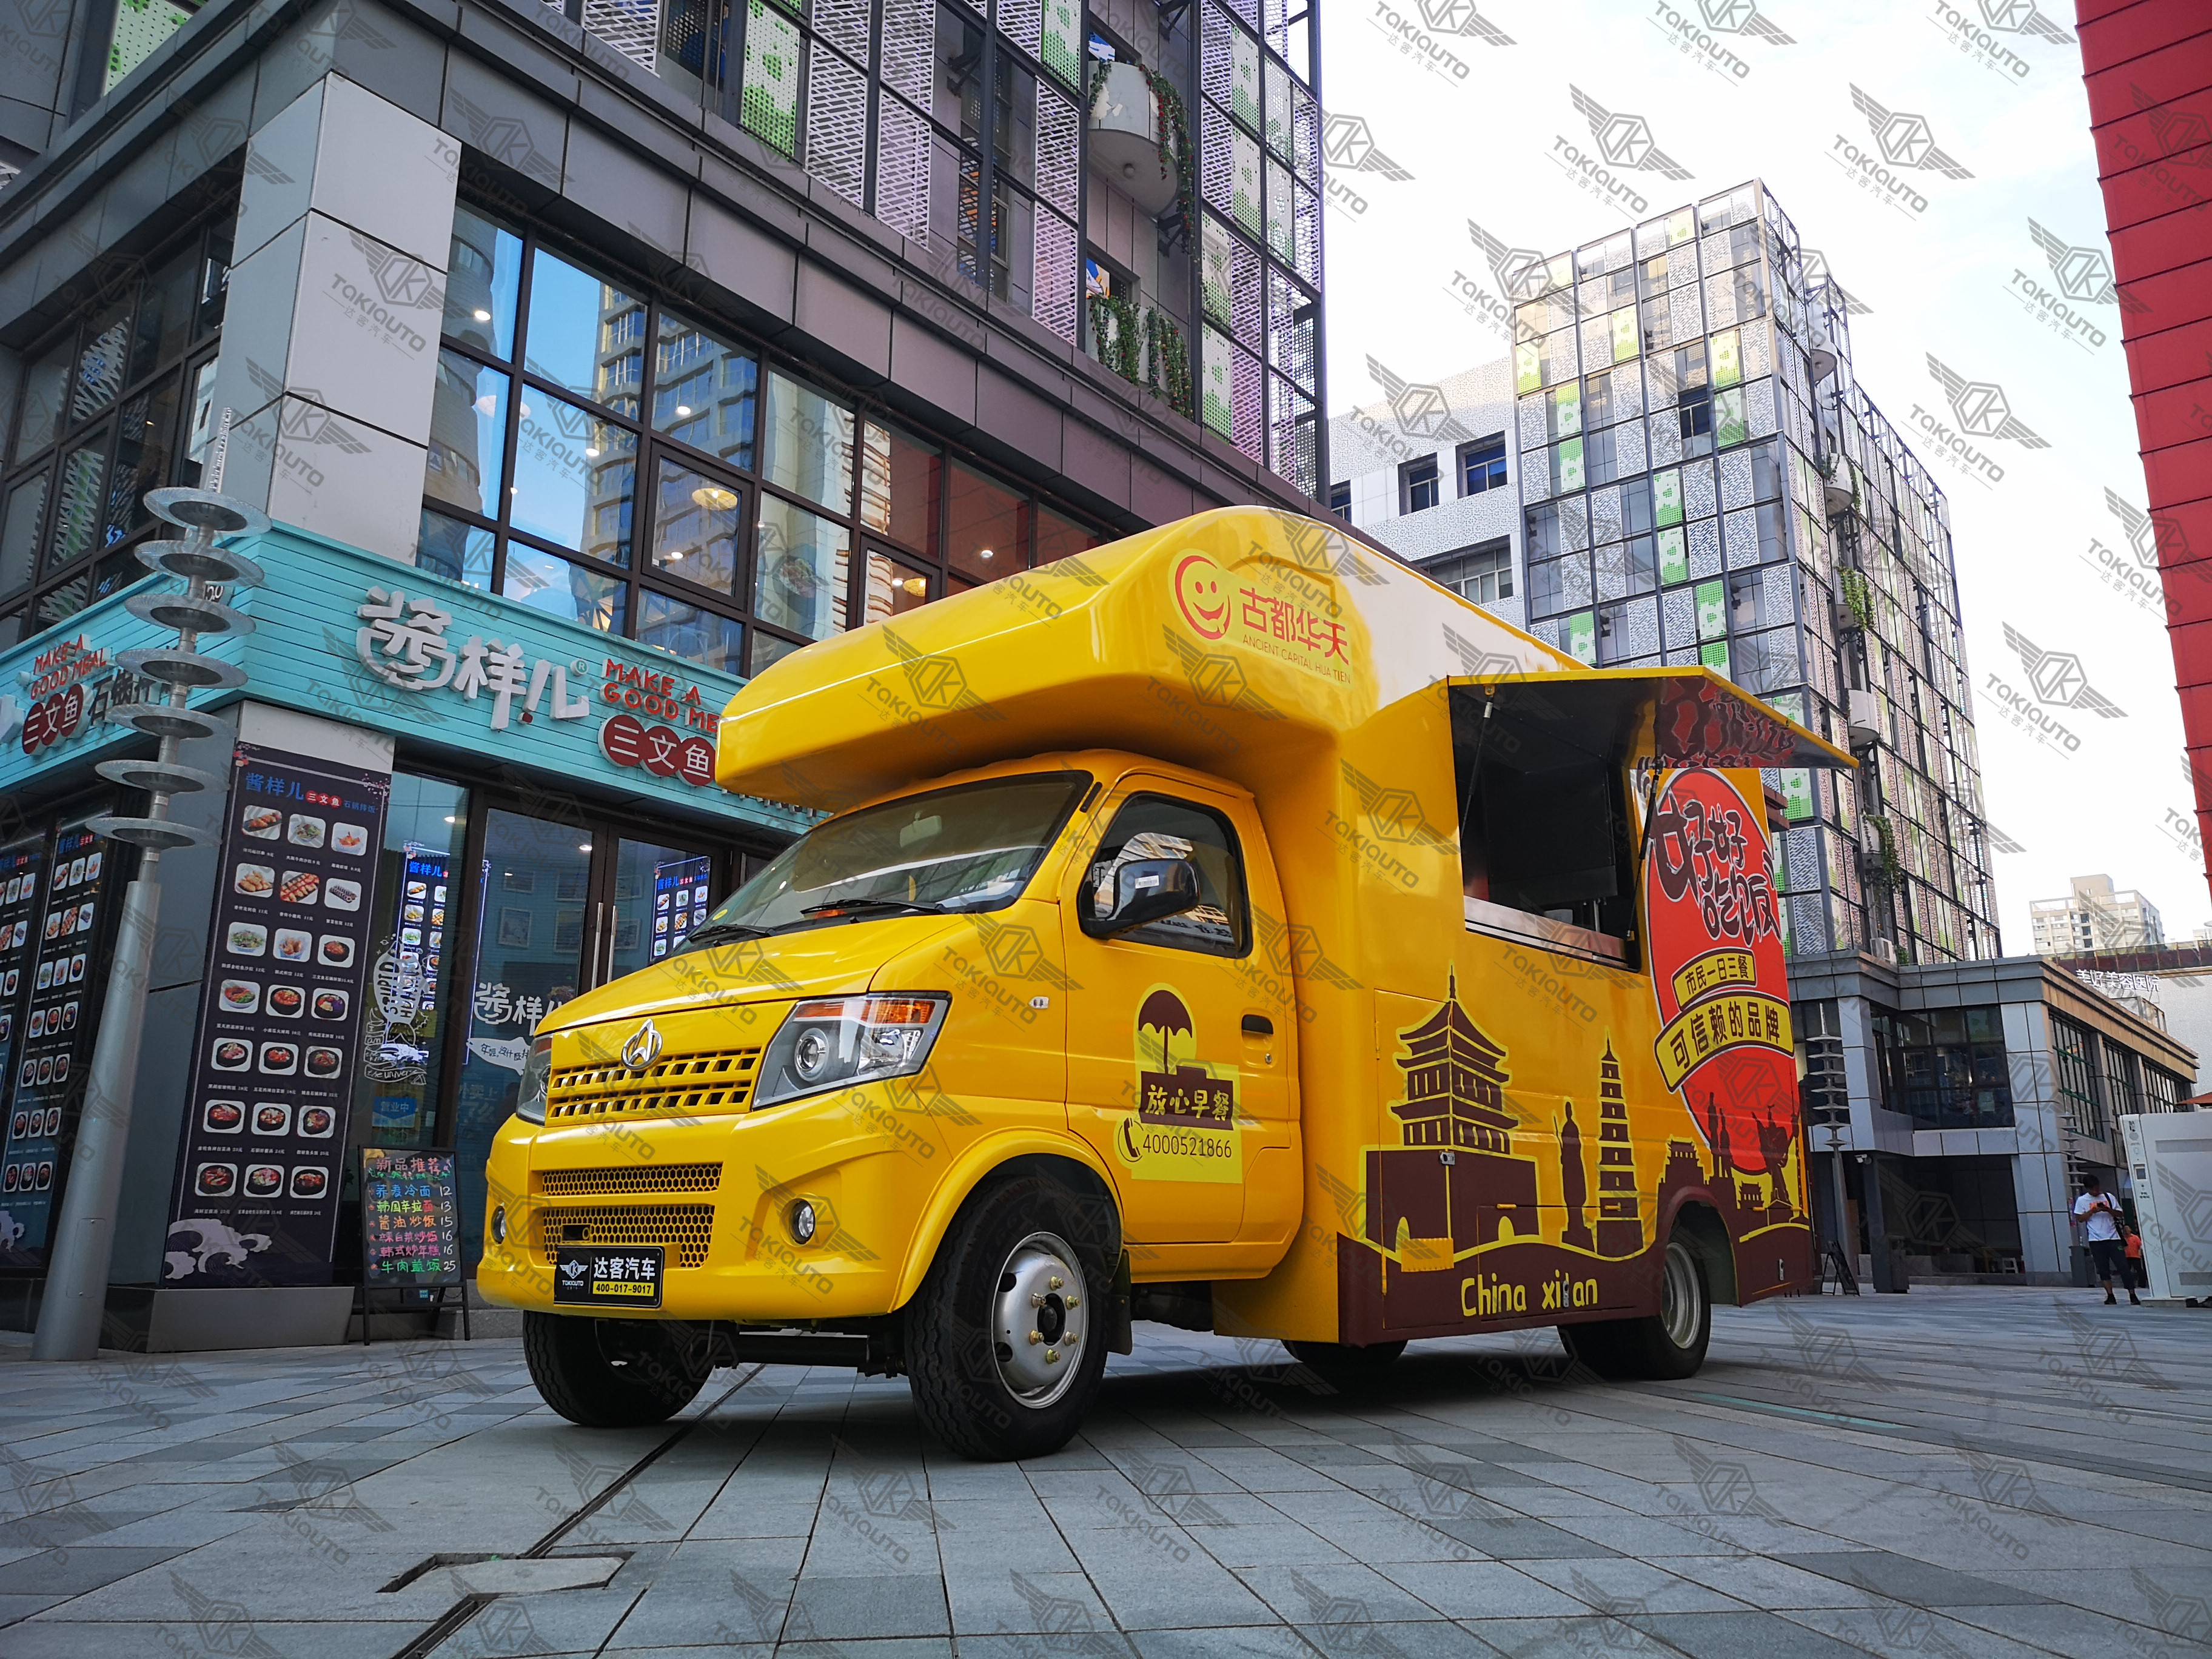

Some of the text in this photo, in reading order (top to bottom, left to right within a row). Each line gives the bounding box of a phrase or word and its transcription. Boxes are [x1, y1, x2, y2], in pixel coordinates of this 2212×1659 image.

[1239, 586, 1350, 666] 古都华天
[31, 648, 107, 700] GOOD MEAL
[33, 634, 84, 676] MAKE A
[1242, 634, 1352, 685] ANCIENT CAPITAL HUA TIEN
[603, 682, 680, 720] GOOD
[605, 658, 702, 706] MAKE A
[23, 694, 79, 745] 三文鱼
[609, 722, 711, 779] 三文鱼
[245, 772, 304, 801] 酱样儿
[307, 792, 340, 807] 三文鱼
[377, 961, 400, 1015] STUPID
[1684, 954, 1749, 996] 市民一日三餐
[1669, 1000, 1780, 1070] 可信赖的品牌
[1147, 1084, 1230, 1122] 放心早餐
[1142, 1134, 1232, 1159] 4000521866
[376, 1157, 441, 1176] 新品推荐
[377, 1200, 452, 1213] 韩国辛拉面 13
[440, 1186, 453, 1198] 12
[378, 1215, 454, 1231] 酱油炒饭 15
[442, 1230, 454, 1241] 16
[379, 1244, 454, 1259] 韩式炒年糕 16
[381, 1258, 457, 1273] 牛肉盖饭 25
[594, 1256, 656, 1281] 达客汽车
[595, 1283, 652, 1295] 400-017-9017
[1461, 1273, 1527, 1316] China
